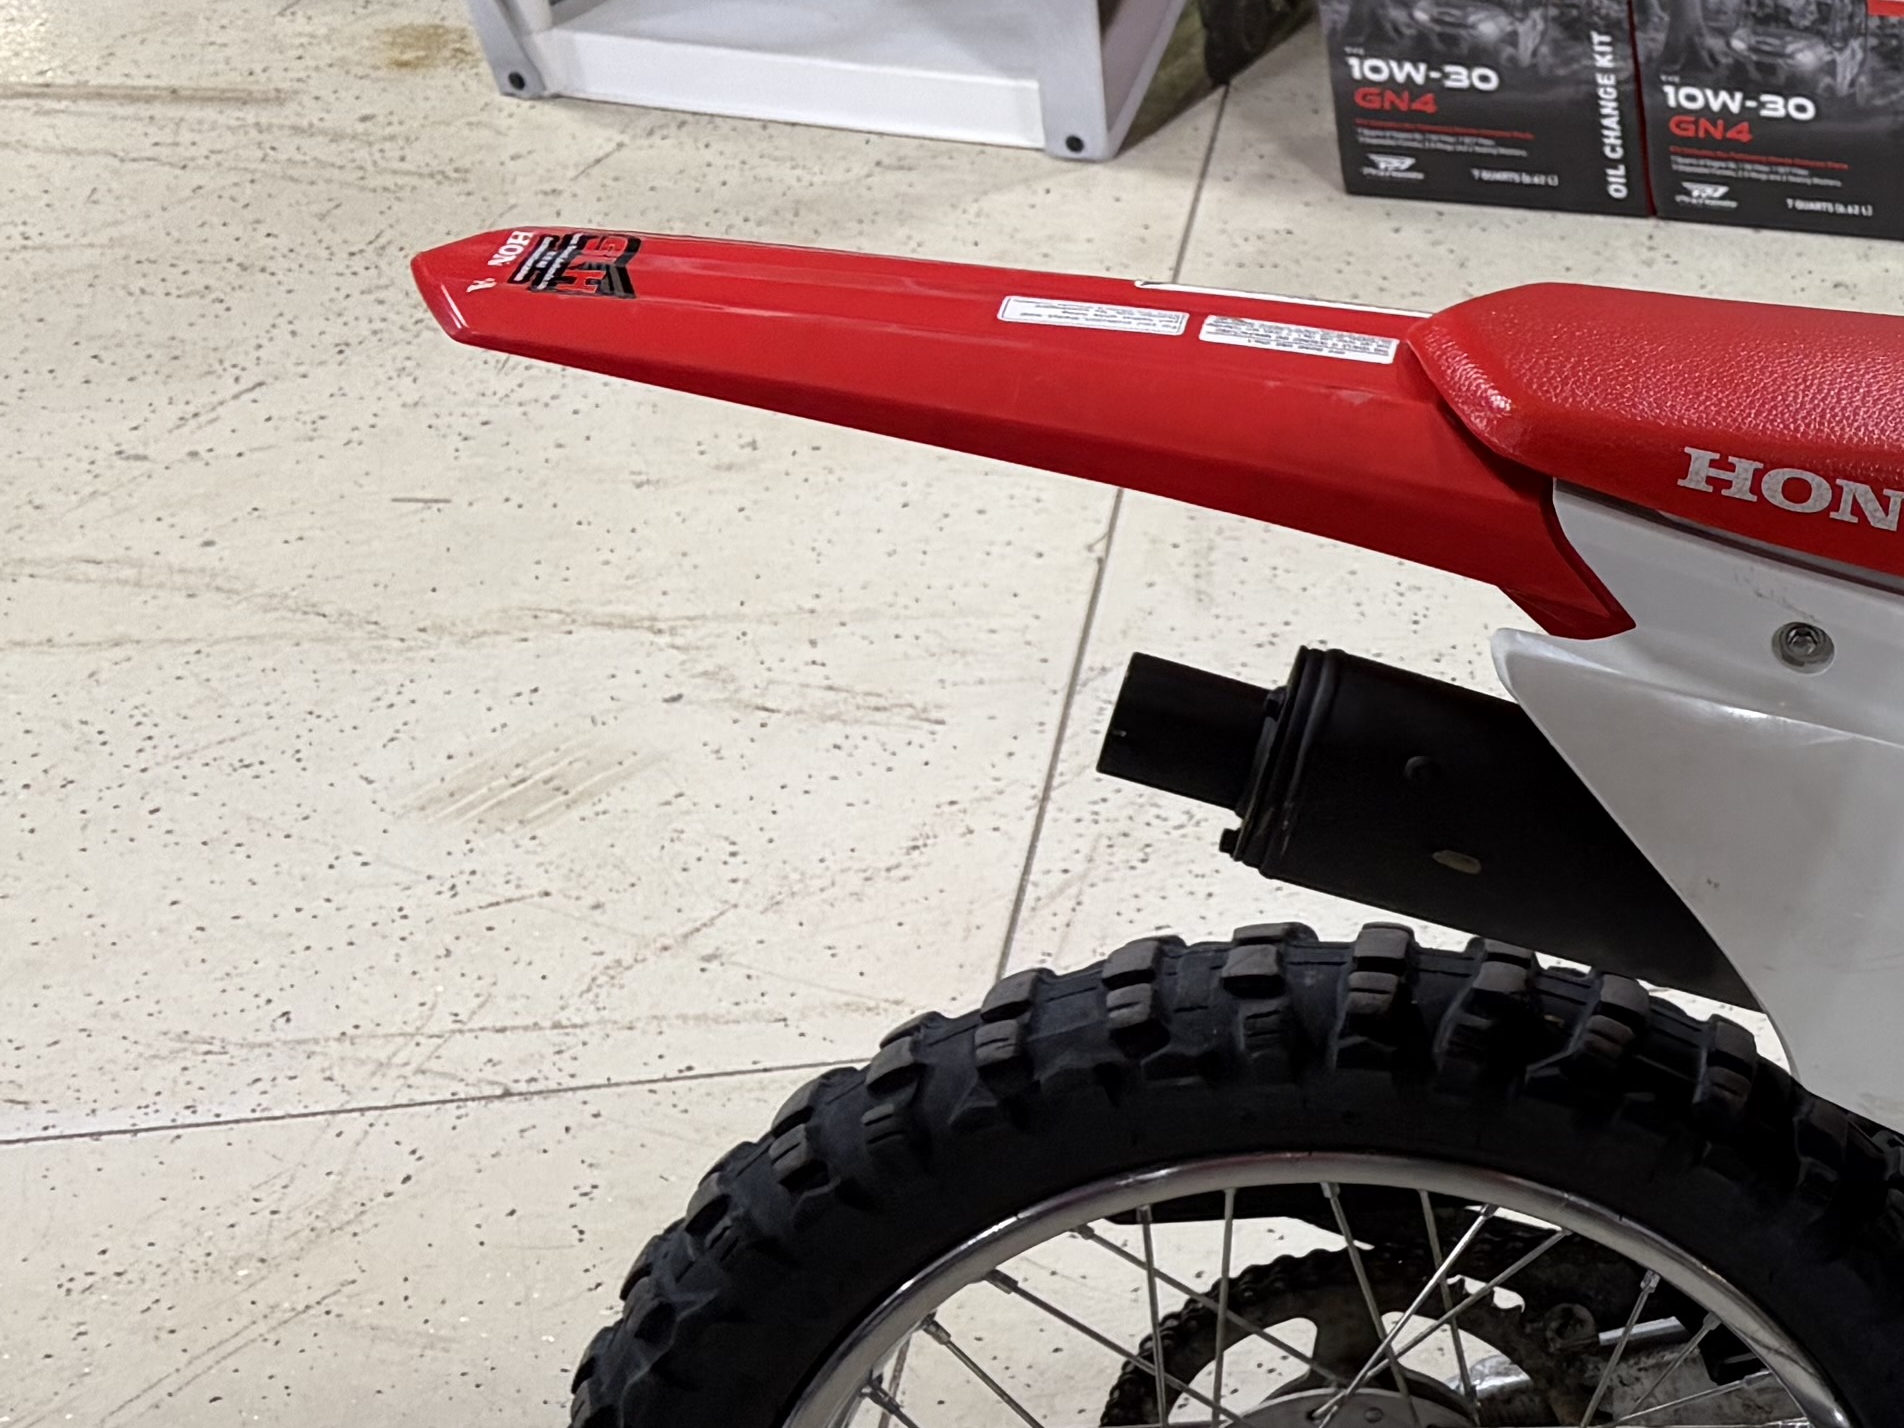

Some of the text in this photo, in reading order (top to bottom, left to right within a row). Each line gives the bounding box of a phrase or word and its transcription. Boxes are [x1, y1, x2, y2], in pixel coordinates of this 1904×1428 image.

[1346, 56, 1500, 91] 10W-30
[1354, 87, 1439, 113] GN4
[1590, 31, 1628, 200] OIL CHANGE KIT
[1662, 84, 1816, 121] 10W-30
[1669, 114, 1753, 143] GN4
